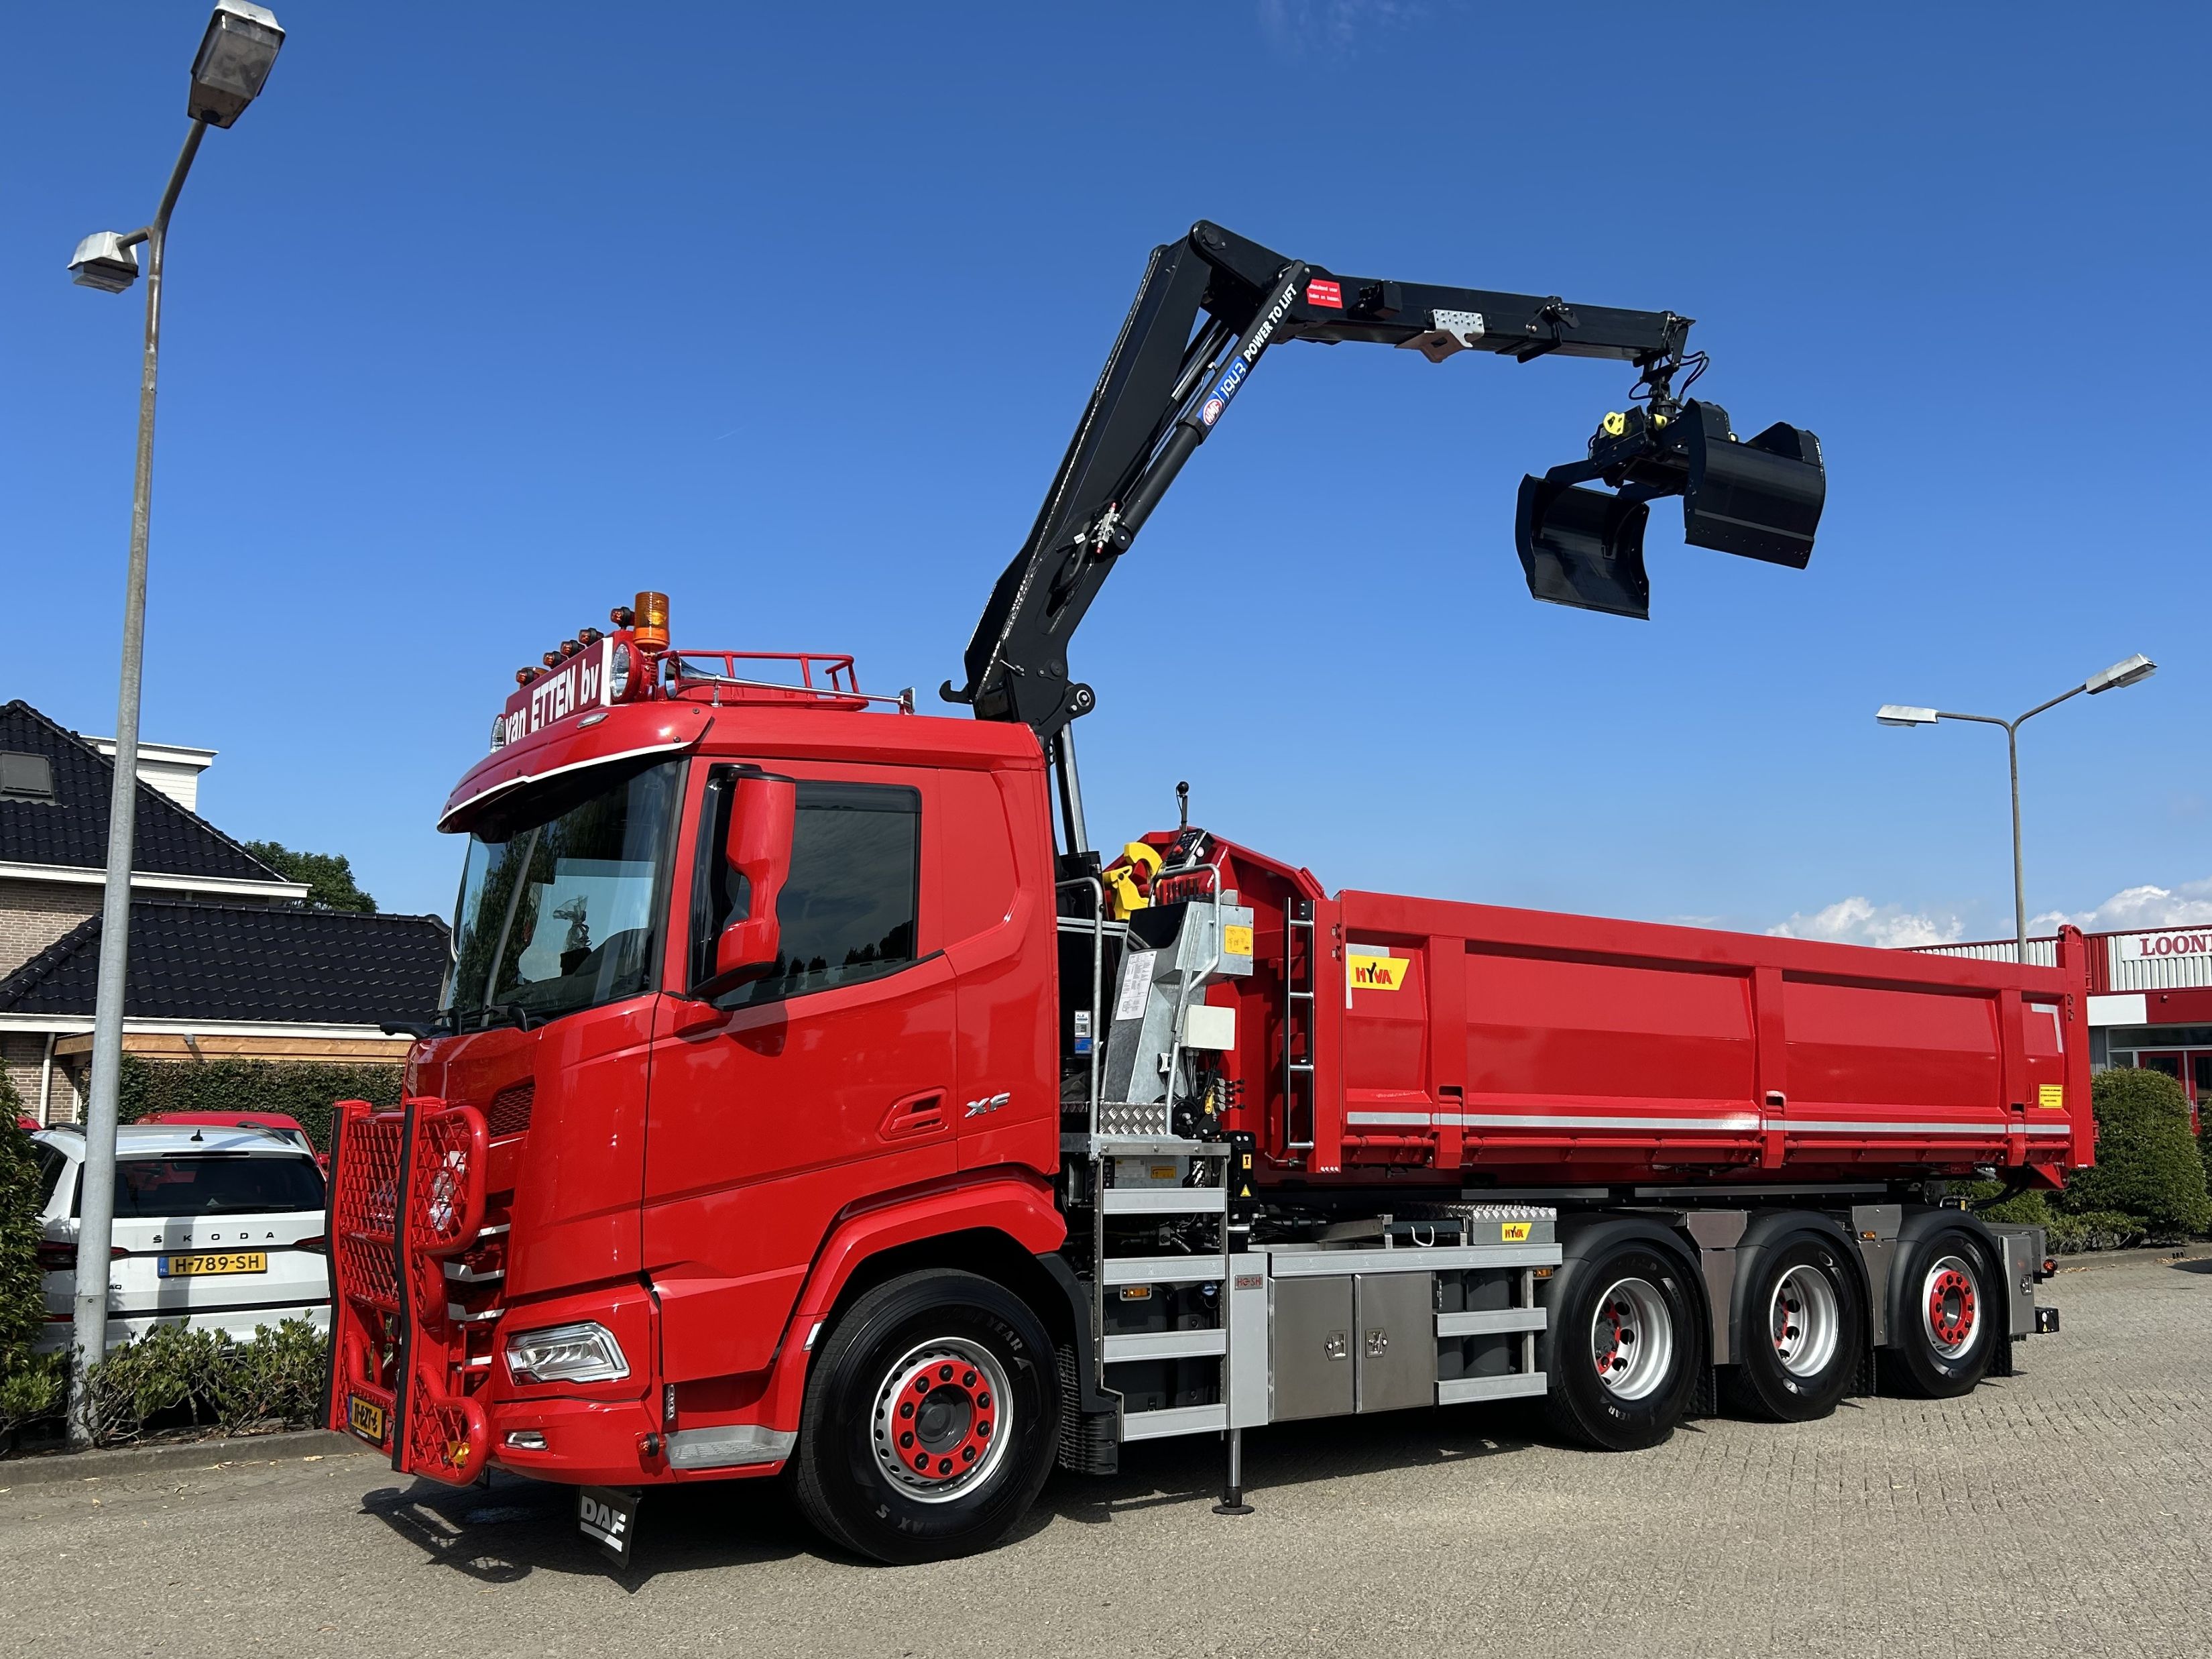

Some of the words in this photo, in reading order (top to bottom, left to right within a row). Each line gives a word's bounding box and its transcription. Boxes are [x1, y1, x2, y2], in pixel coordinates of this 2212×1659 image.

[1243, 321, 1273, 362] POWER
[1268, 306, 1283, 324] TO
[1278, 283, 1297, 310] LIFT
[1220, 362, 1246, 400] 1943
[506, 707, 526, 745] van
[531, 665, 576, 732] ETTEN
[580, 659, 599, 705] bv
[2140, 934, 2212, 956] LOON
[1355, 962, 1393, 984] HYVA
[965, 1092, 1010, 1118] XF
[1505, 1226, 1523, 1239] HYVA
[175, 1255, 259, 1273] H-789-SH
[581, 1495, 626, 1534] DAF
